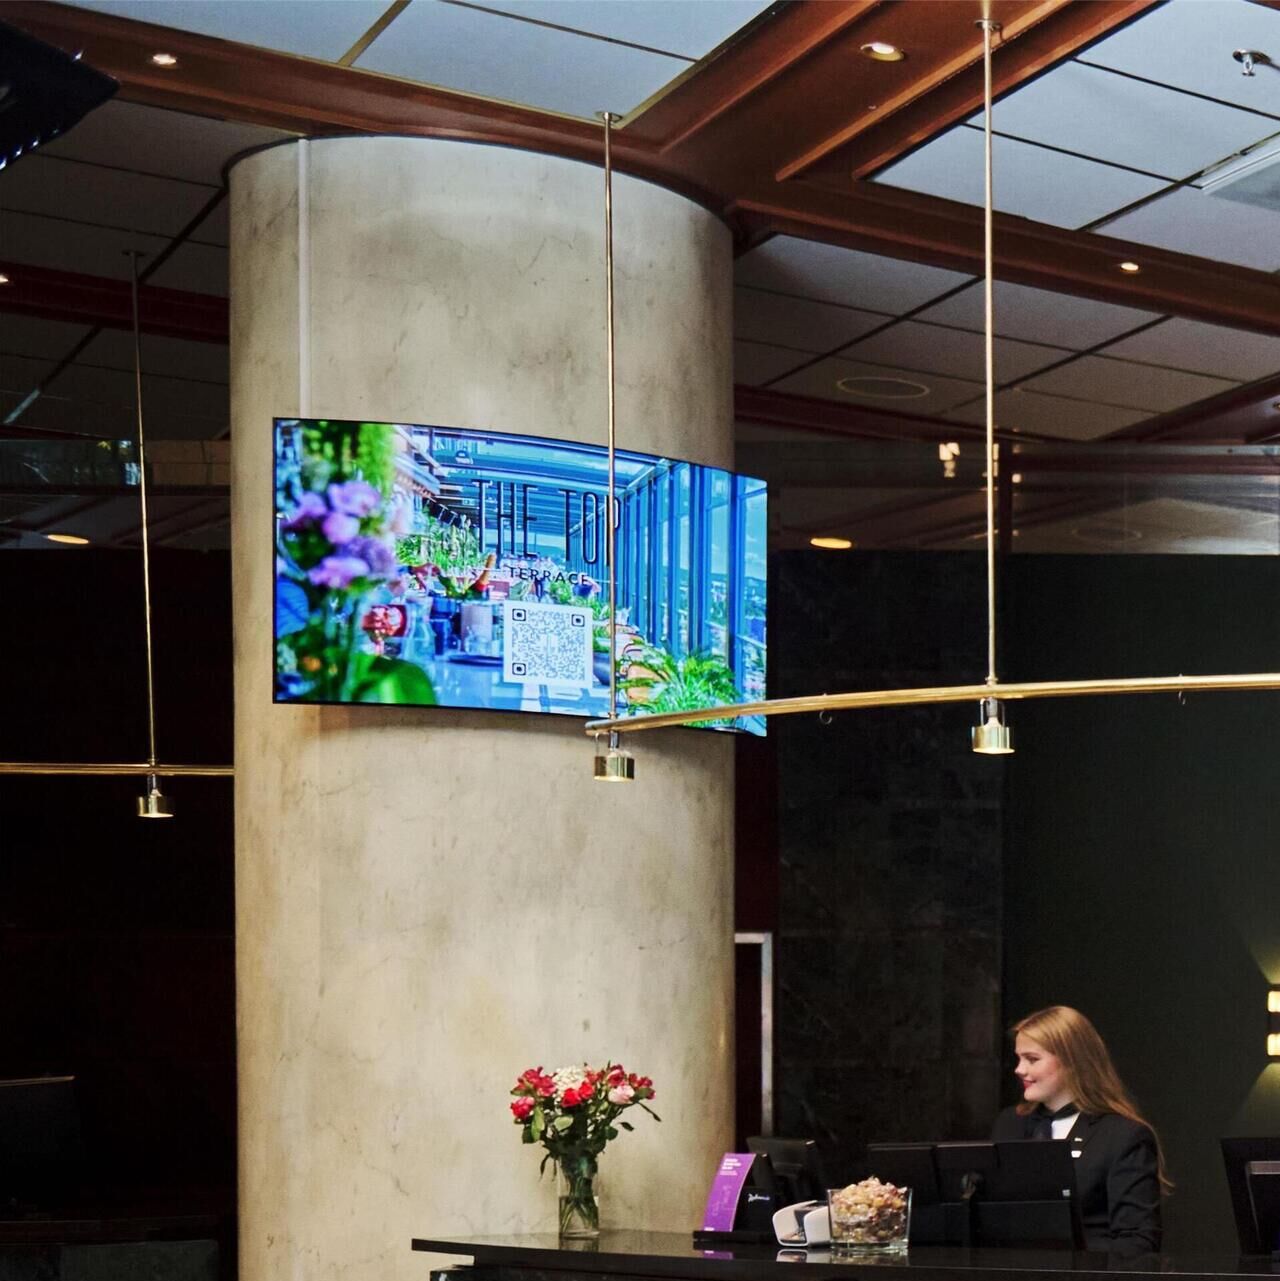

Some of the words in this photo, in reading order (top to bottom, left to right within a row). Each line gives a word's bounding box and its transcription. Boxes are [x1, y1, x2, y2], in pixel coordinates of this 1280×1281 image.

[471, 478, 539, 560] THE
[559, 487, 621, 568] TOP
[509, 567, 589, 585] TERRACE
